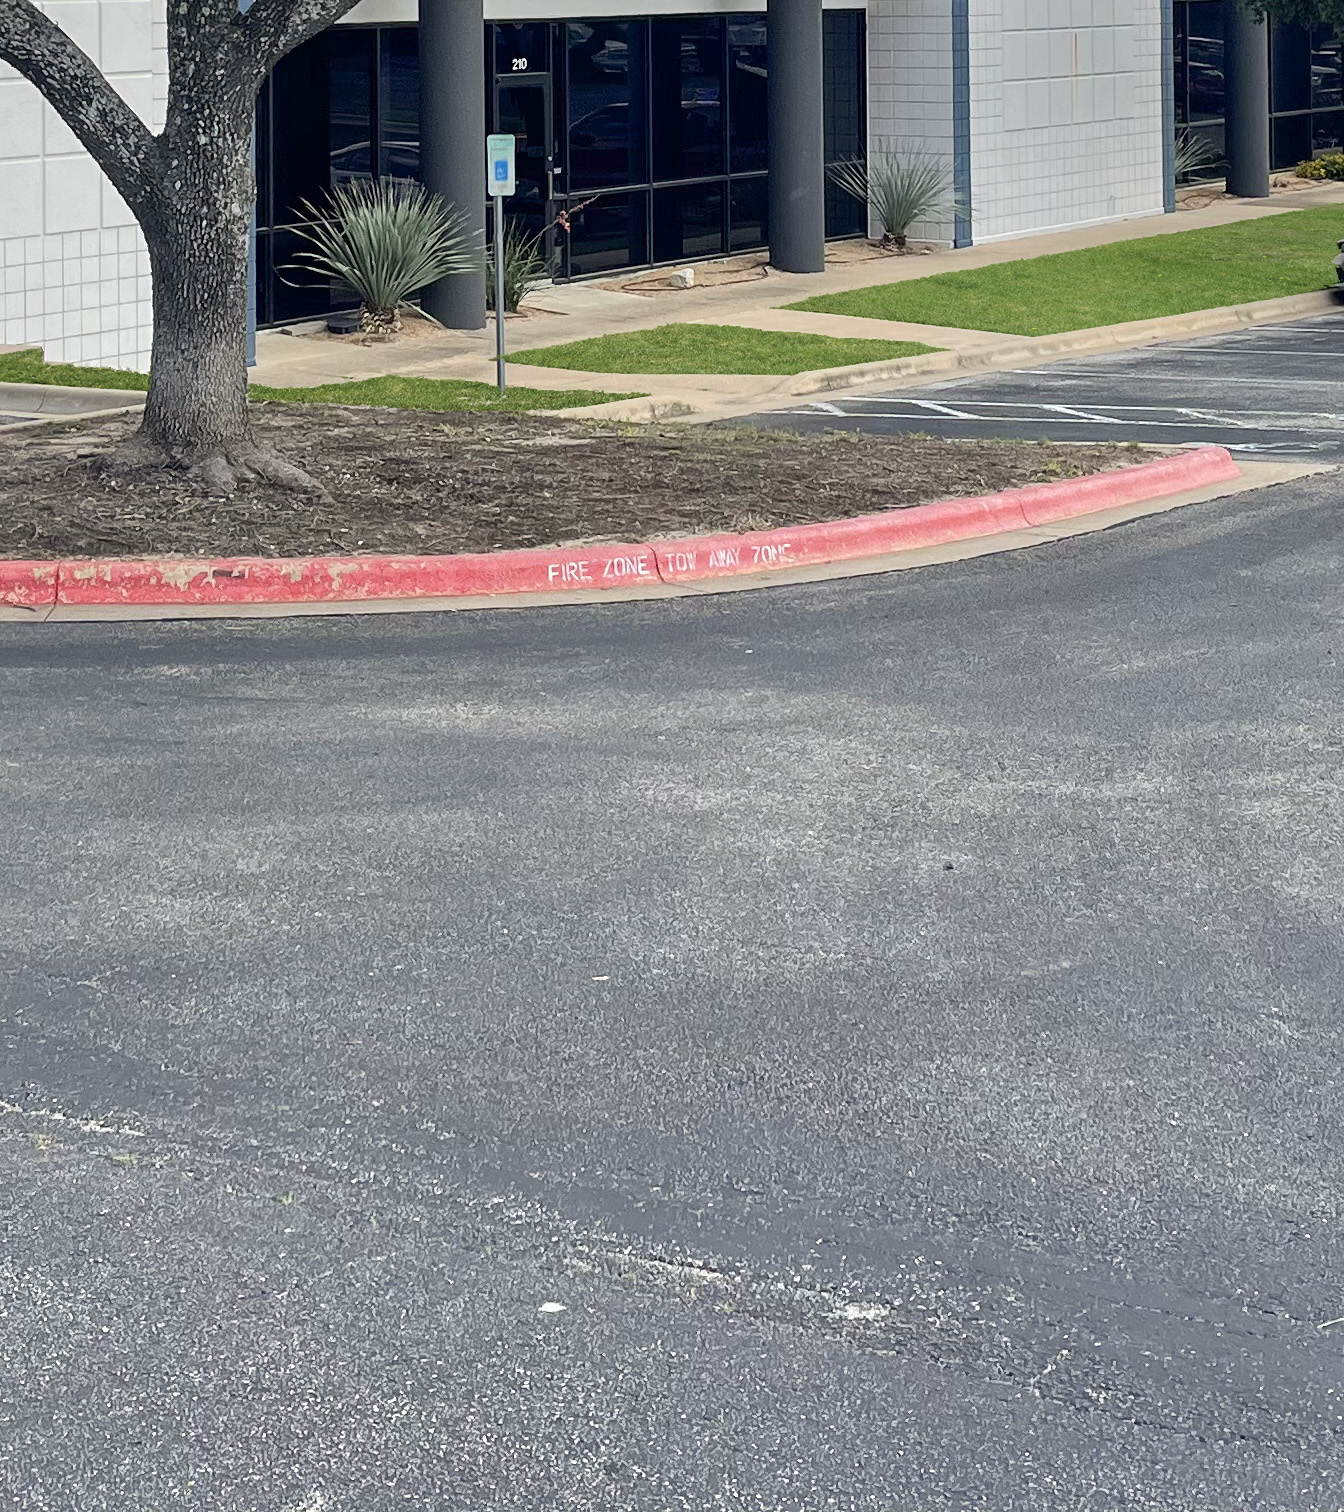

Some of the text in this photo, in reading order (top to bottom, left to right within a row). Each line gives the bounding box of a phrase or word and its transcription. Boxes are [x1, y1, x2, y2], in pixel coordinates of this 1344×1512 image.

[512, 58, 527, 70] 210
[548, 561, 592, 582] FIRE
[602, 556, 650, 578] ZONE
[665, 552, 696, 572] TOW
[709, 547, 741, 568] AWAY
